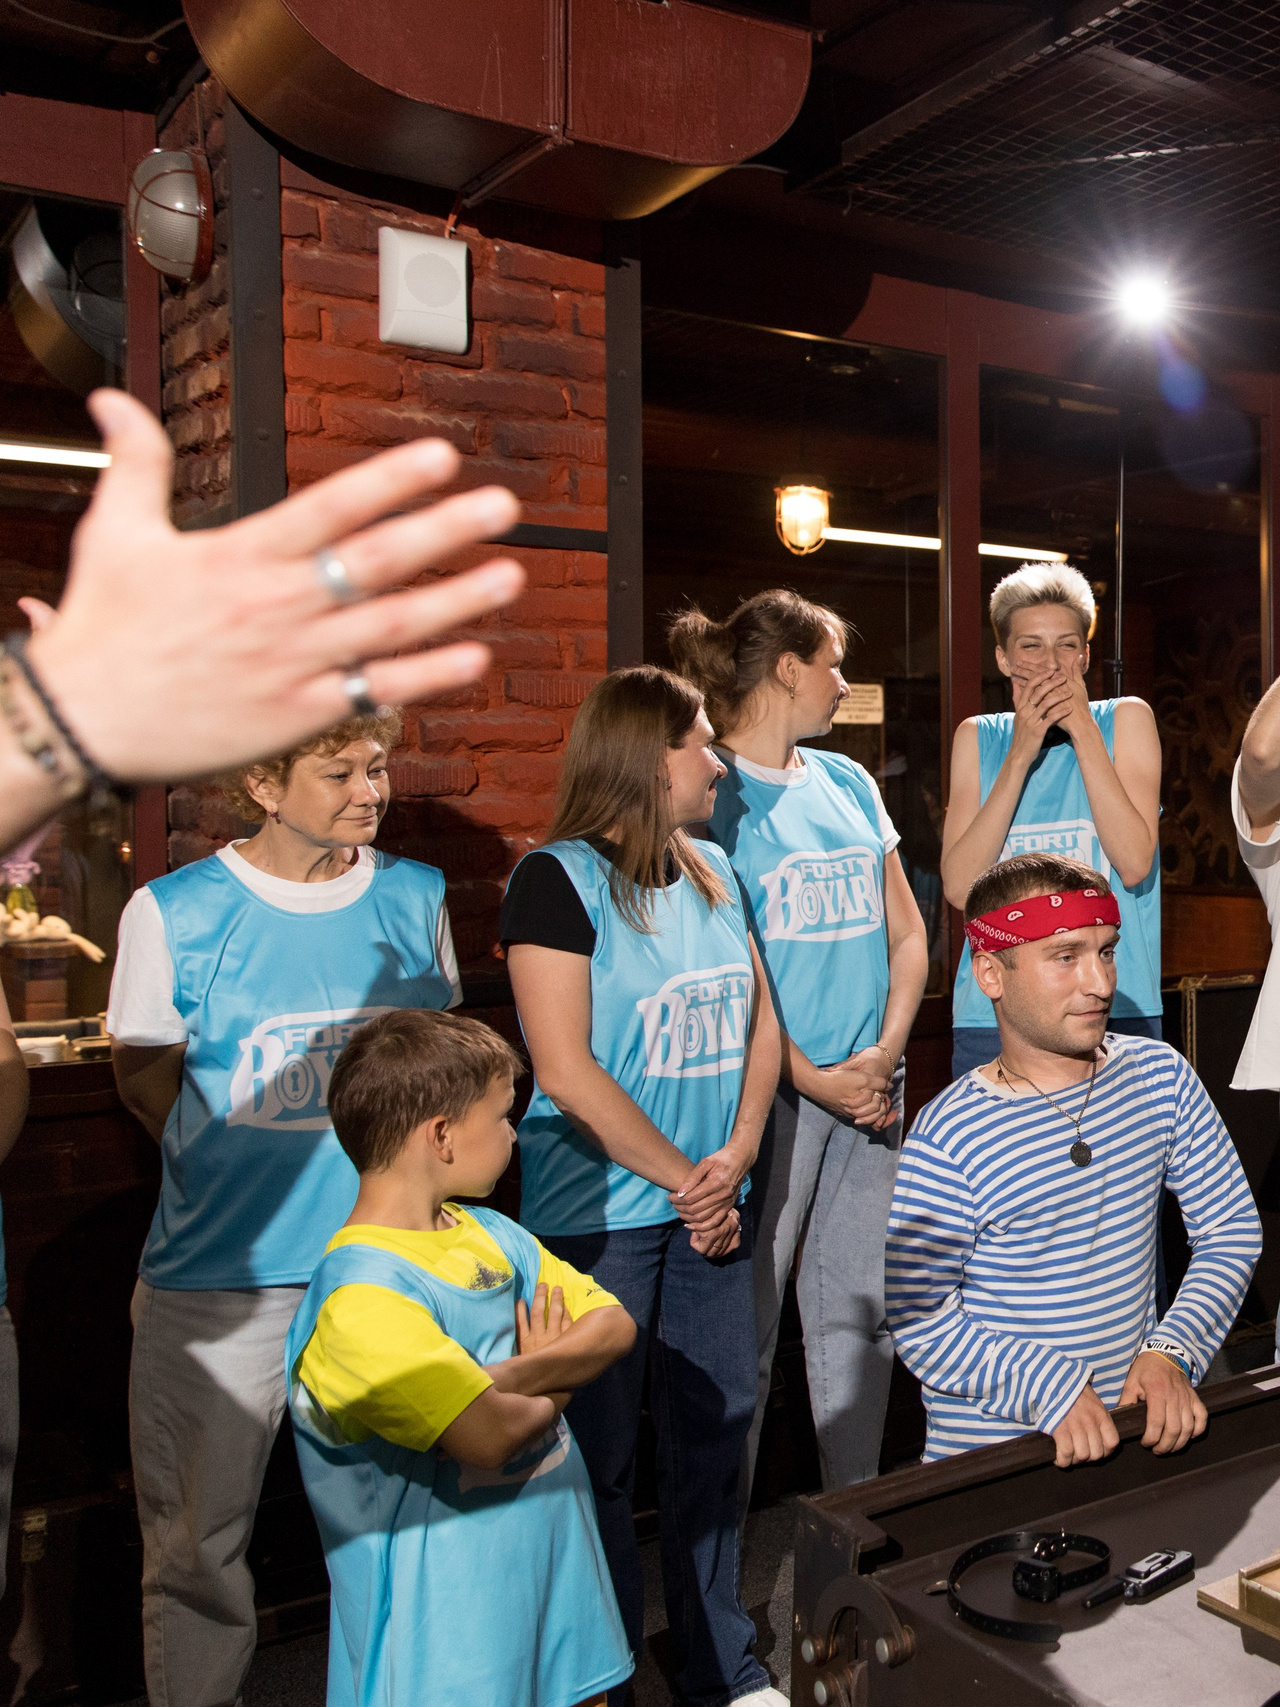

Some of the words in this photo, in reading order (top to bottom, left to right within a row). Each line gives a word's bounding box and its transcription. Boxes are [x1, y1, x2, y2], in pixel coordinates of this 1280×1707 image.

[1009, 831, 1077, 853] FORT
[800, 857, 857, 880] FORT
[759, 857, 884, 942] BOYARD
[684, 976, 741, 1006] FORT
[284, 1023, 358, 1050] FOR
[226, 1033, 342, 1128] BOY
